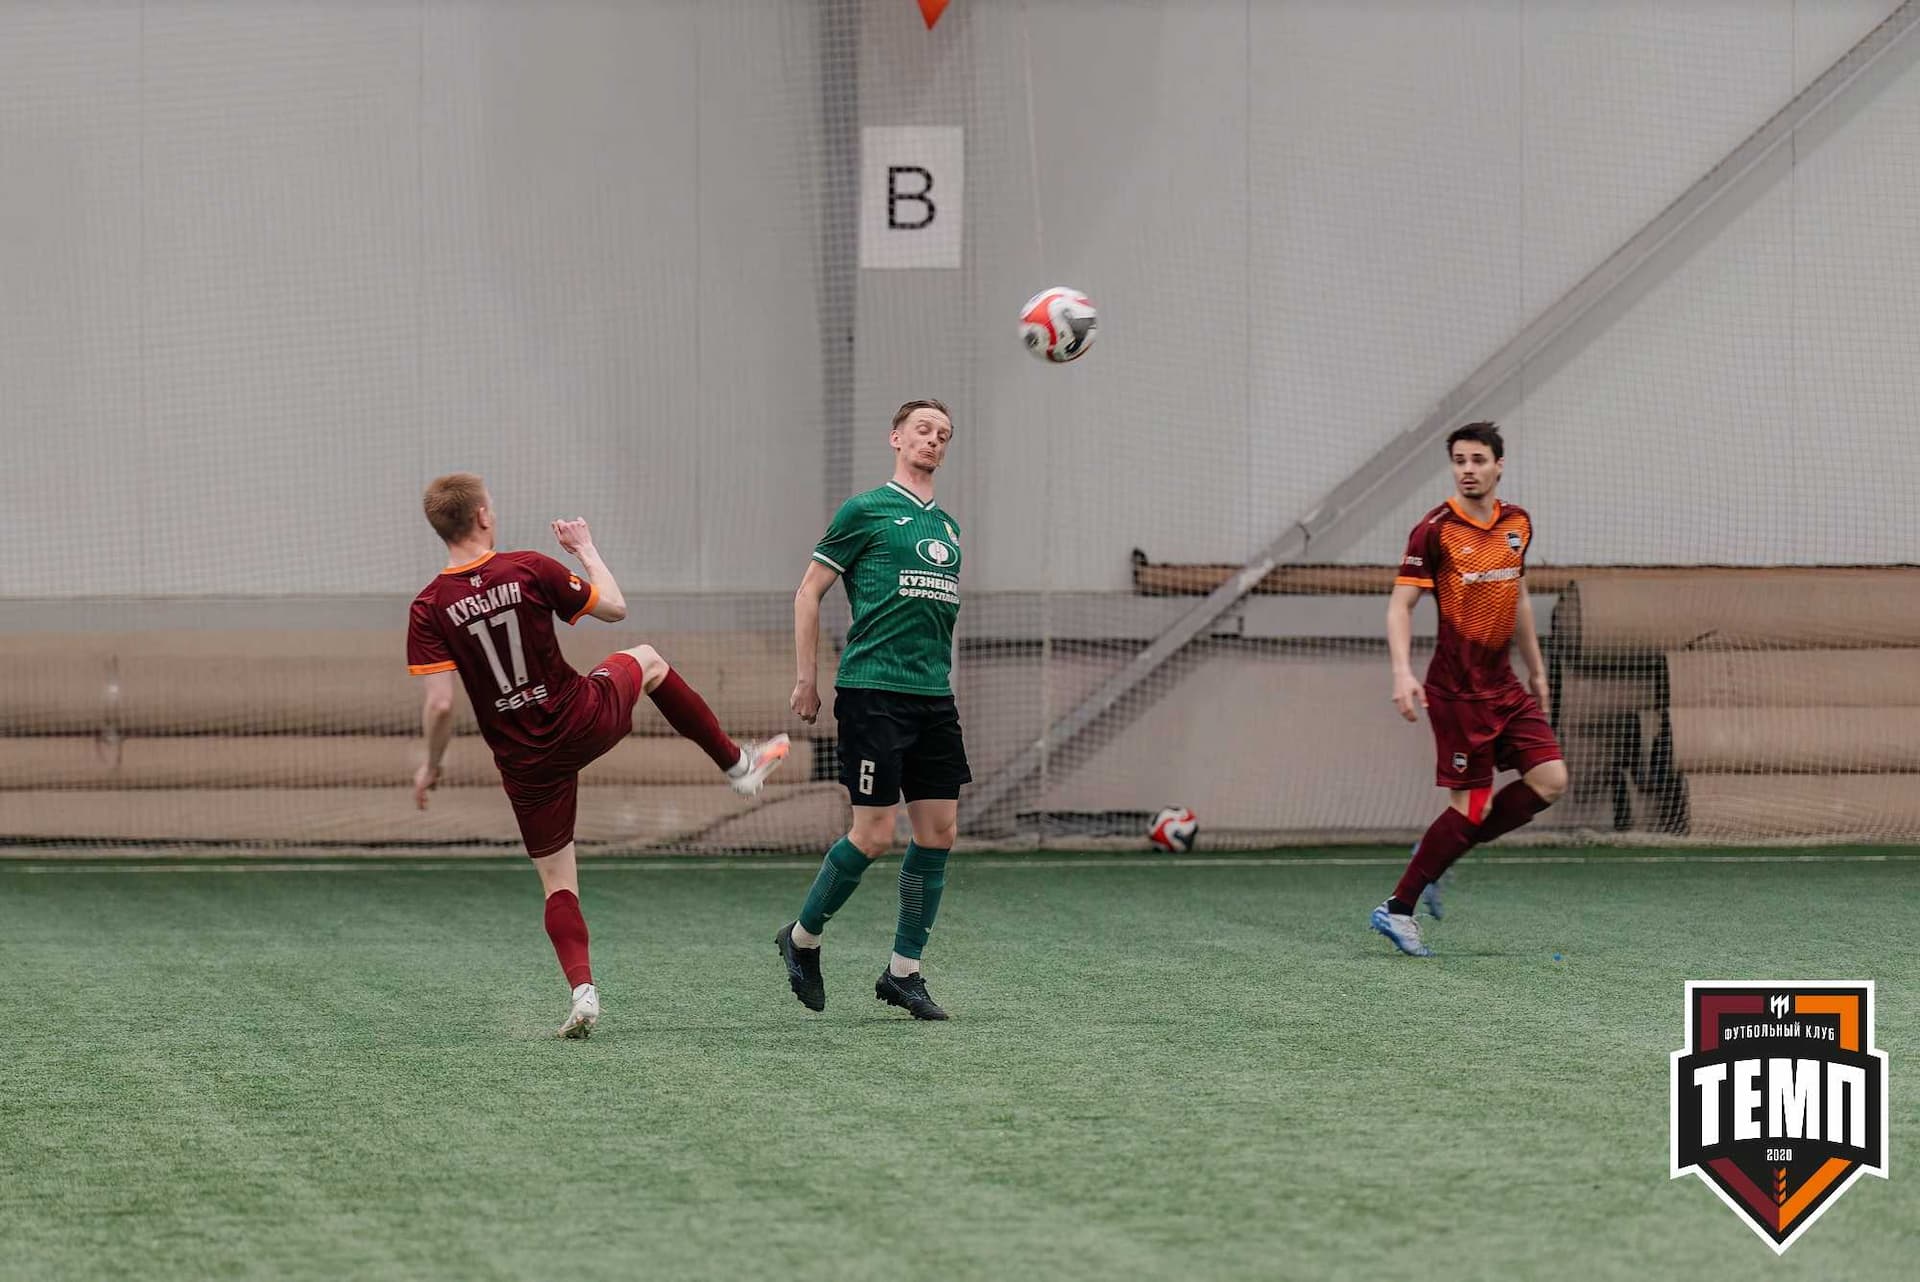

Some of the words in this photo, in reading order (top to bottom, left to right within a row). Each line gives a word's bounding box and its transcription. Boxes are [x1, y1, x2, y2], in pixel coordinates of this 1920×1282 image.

[446, 582, 522, 626] КУЗЬКИН
[468, 608, 528, 695] 17
[859, 759, 875, 795] 6
